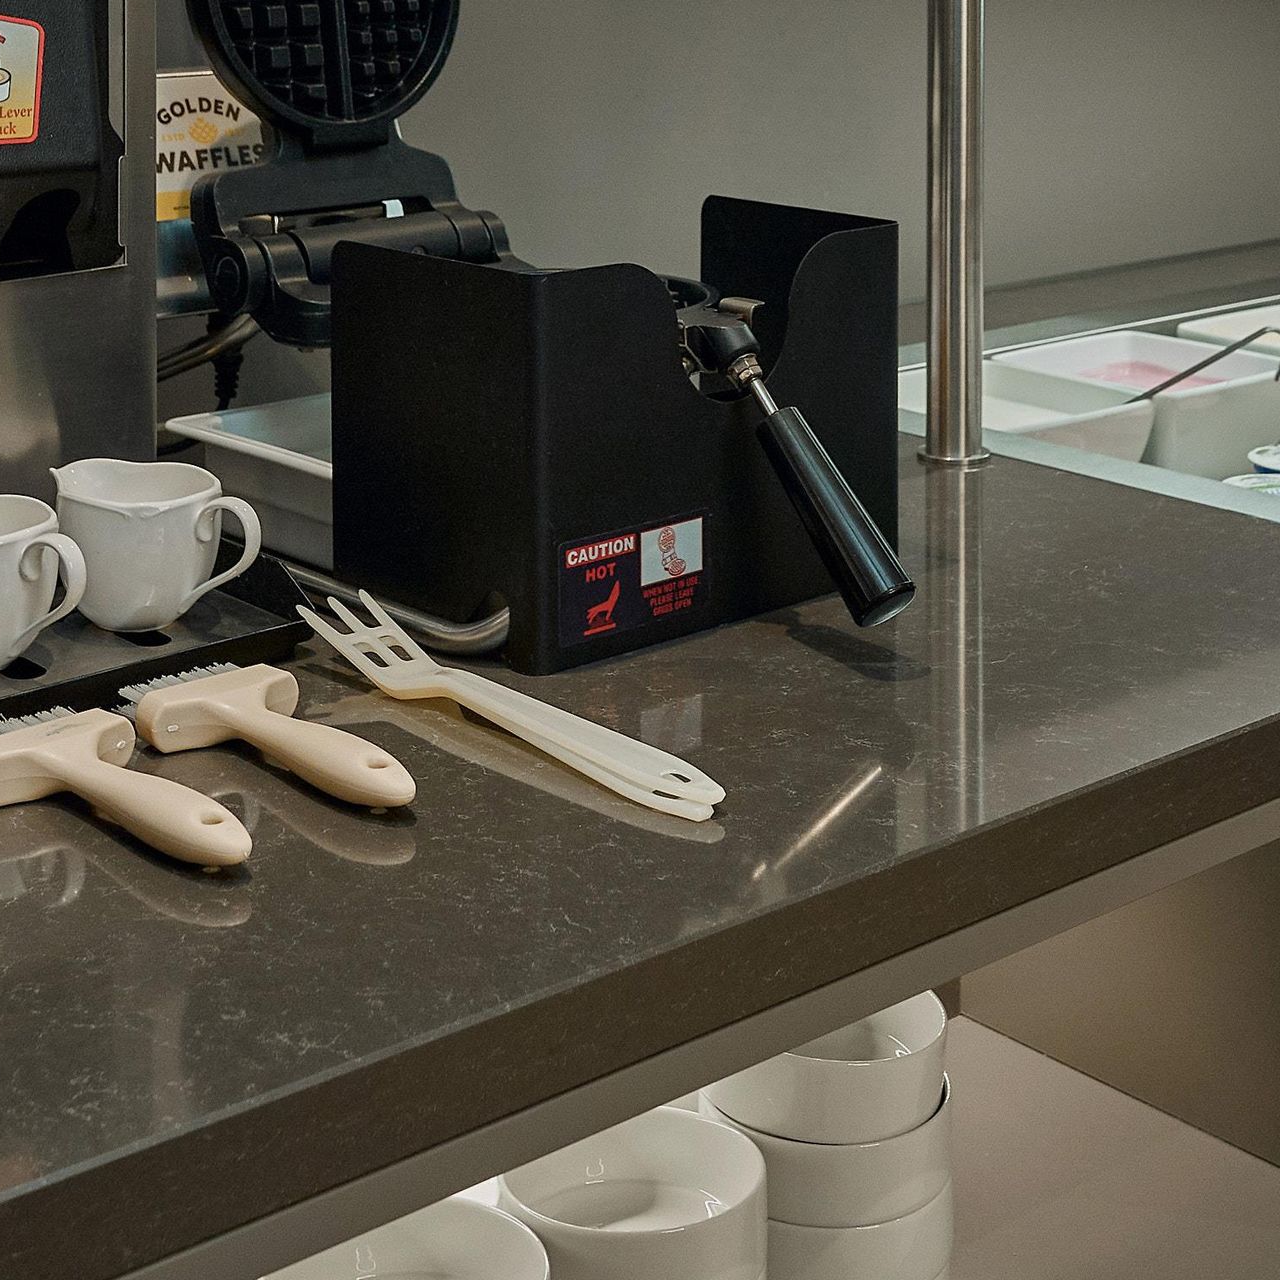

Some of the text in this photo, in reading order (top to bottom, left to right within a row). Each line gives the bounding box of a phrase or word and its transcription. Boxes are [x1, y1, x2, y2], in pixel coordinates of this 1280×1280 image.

[0, 106, 32, 119] Lever
[157, 97, 240, 125] GOLDEN
[567, 536, 634, 565] CAUTION
[586, 563, 616, 582] HOT
